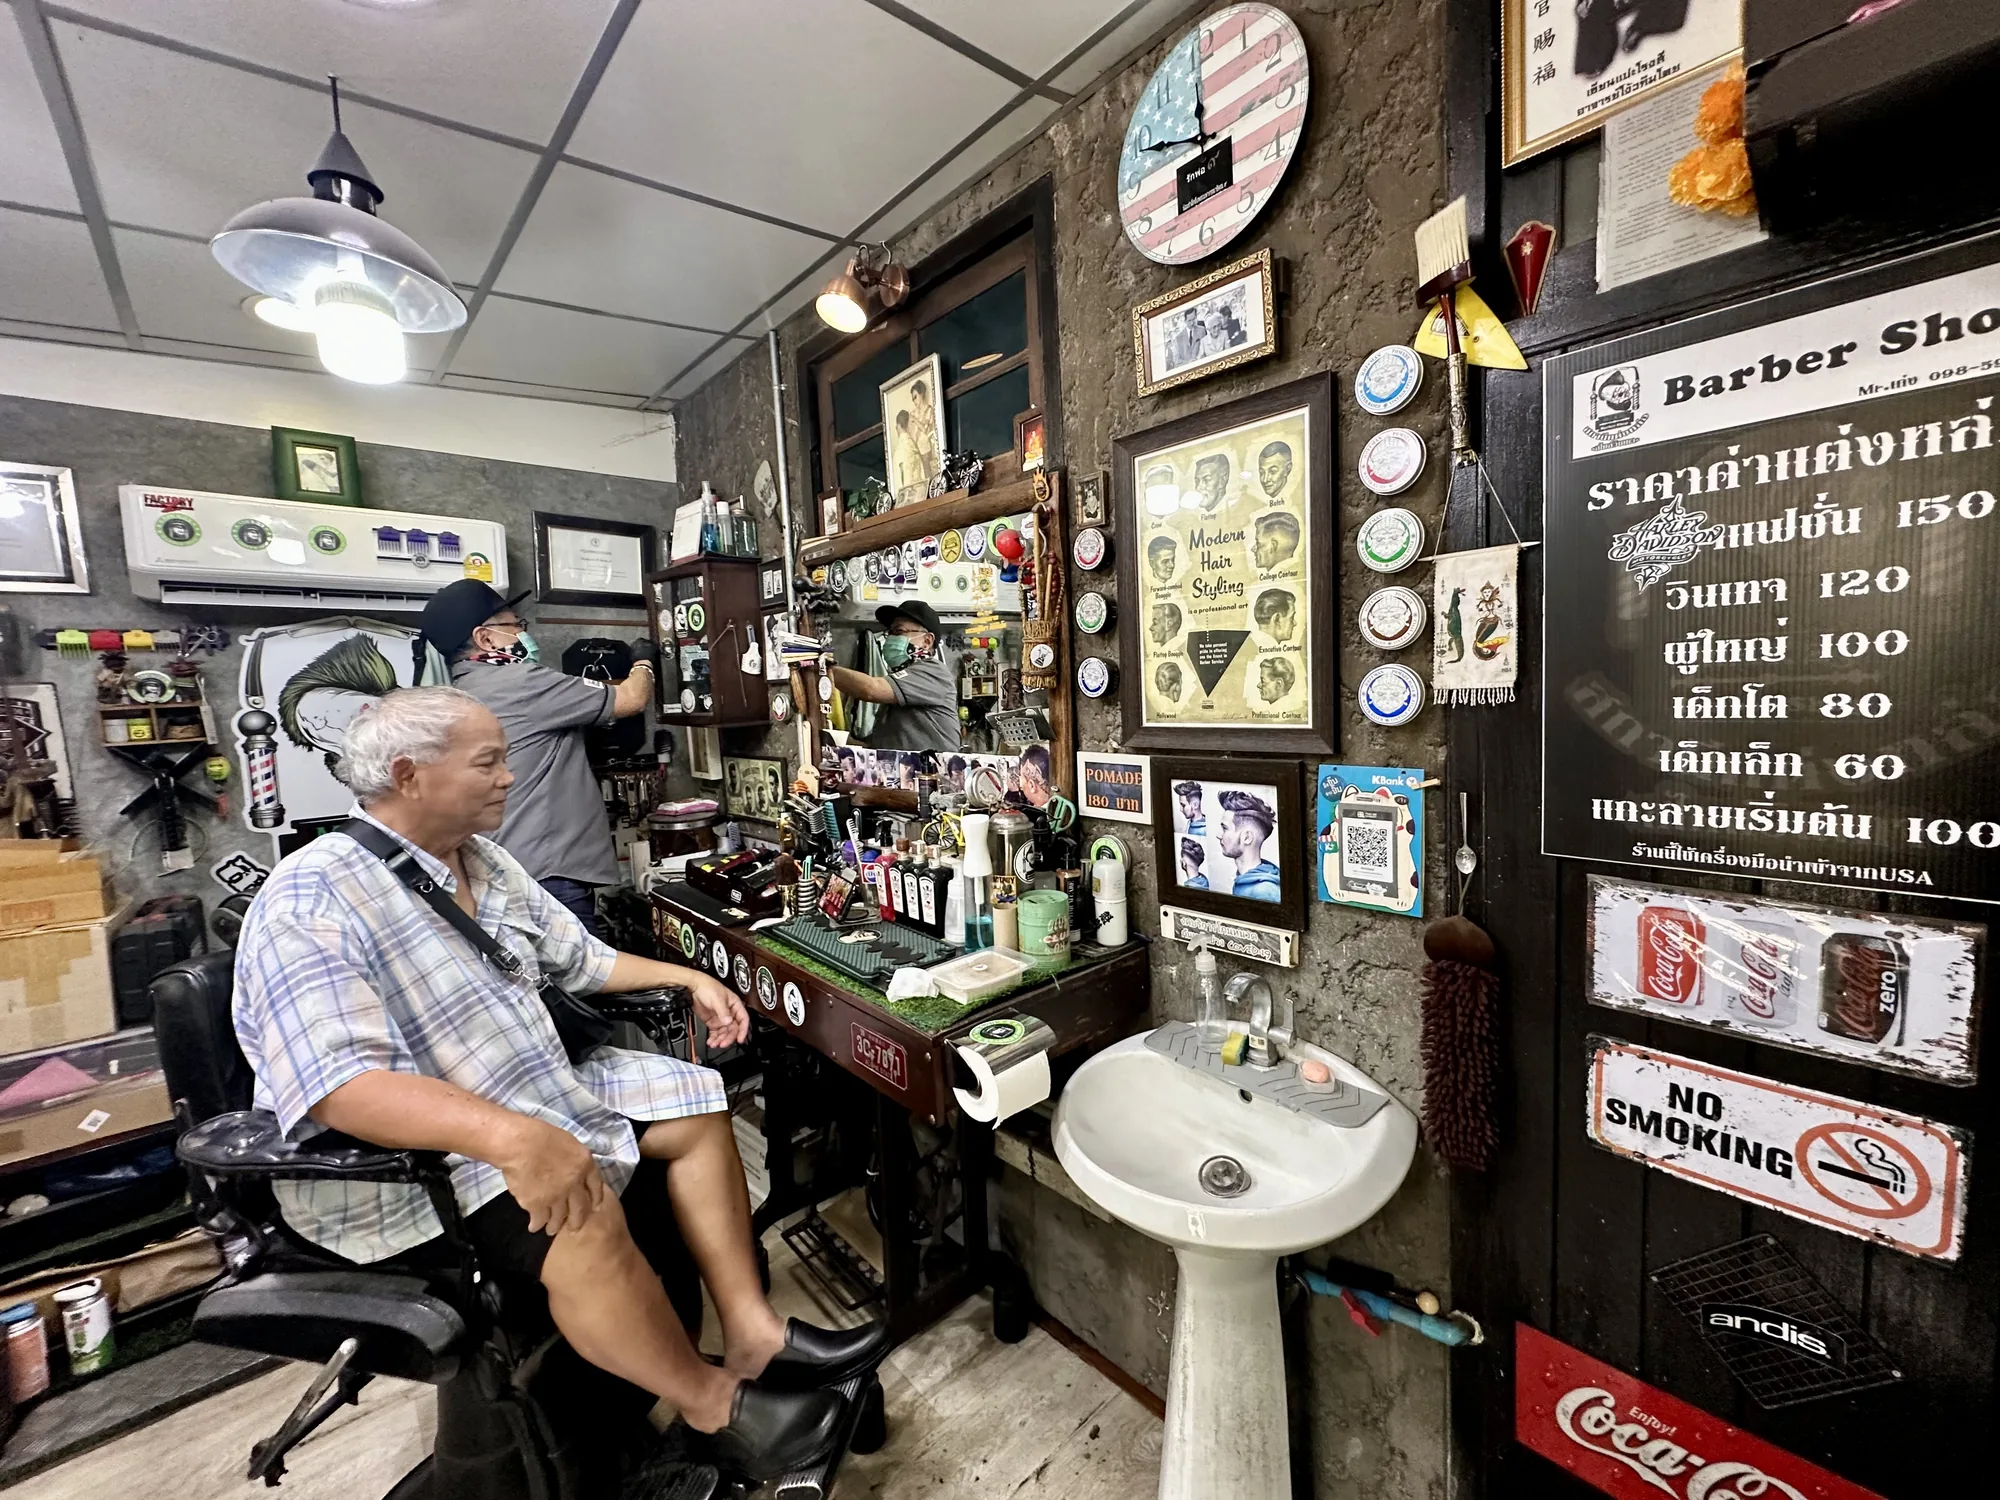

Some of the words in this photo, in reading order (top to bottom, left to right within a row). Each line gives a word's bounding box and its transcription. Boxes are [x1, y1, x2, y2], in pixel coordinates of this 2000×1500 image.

[1189, 29, 1215, 73] 12
[1239, 18, 1250, 52] 1
[1264, 33, 1283, 73] 2
[1155, 74, 1170, 111] 11
[1274, 75, 1296, 109] 3
[1133, 124, 1152, 160] 10
[1264, 126, 1286, 162] 4
[1127, 171, 1142, 200] 9
[1236, 180, 1255, 214] 5
[1139, 207, 1153, 235] 8
[1199, 216, 1217, 247] 6
[1164, 224, 1180, 255] 7
[1664, 341, 1857, 407] Barber
[143, 493, 194, 508] FACTORY
[1897, 490, 1997, 529] 150
[1189, 527, 1246, 550] Modern
[1200, 550, 1232, 573] Hair
[1278, 570, 1298, 580] Contour
[1192, 576, 1244, 601] Styling
[1665, 577, 1788, 610] วินเทจ
[1820, 566, 1911, 599] 120
[1199, 603, 1237, 614] professional
[1664, 617, 1788, 675] ผู้ใหญ่
[1819, 630, 1910, 659] 100
[1672, 684, 1788, 719] เด็กโต
[1819, 692, 1893, 719] 80
[1086, 768, 1143, 786] POMADE
[1659, 741, 1803, 777] เด็กเล็ก
[1834, 754, 1907, 780] 60
[1372, 775, 1404, 786] KBank
[1088, 794, 1109, 808] 180
[1116, 797, 1139, 812] บาท
[1592, 791, 1872, 840] แกะลายเริ่มต้น
[1906, 817, 2000, 849] 100
[1880, 970, 1897, 1014] zero
[1668, 1083, 1722, 1121] NO
[1606, 1099, 1794, 1180] SMOKING
[1709, 1311, 1827, 1357] andis
[1629, 1405, 1678, 1437] Enjoy!
